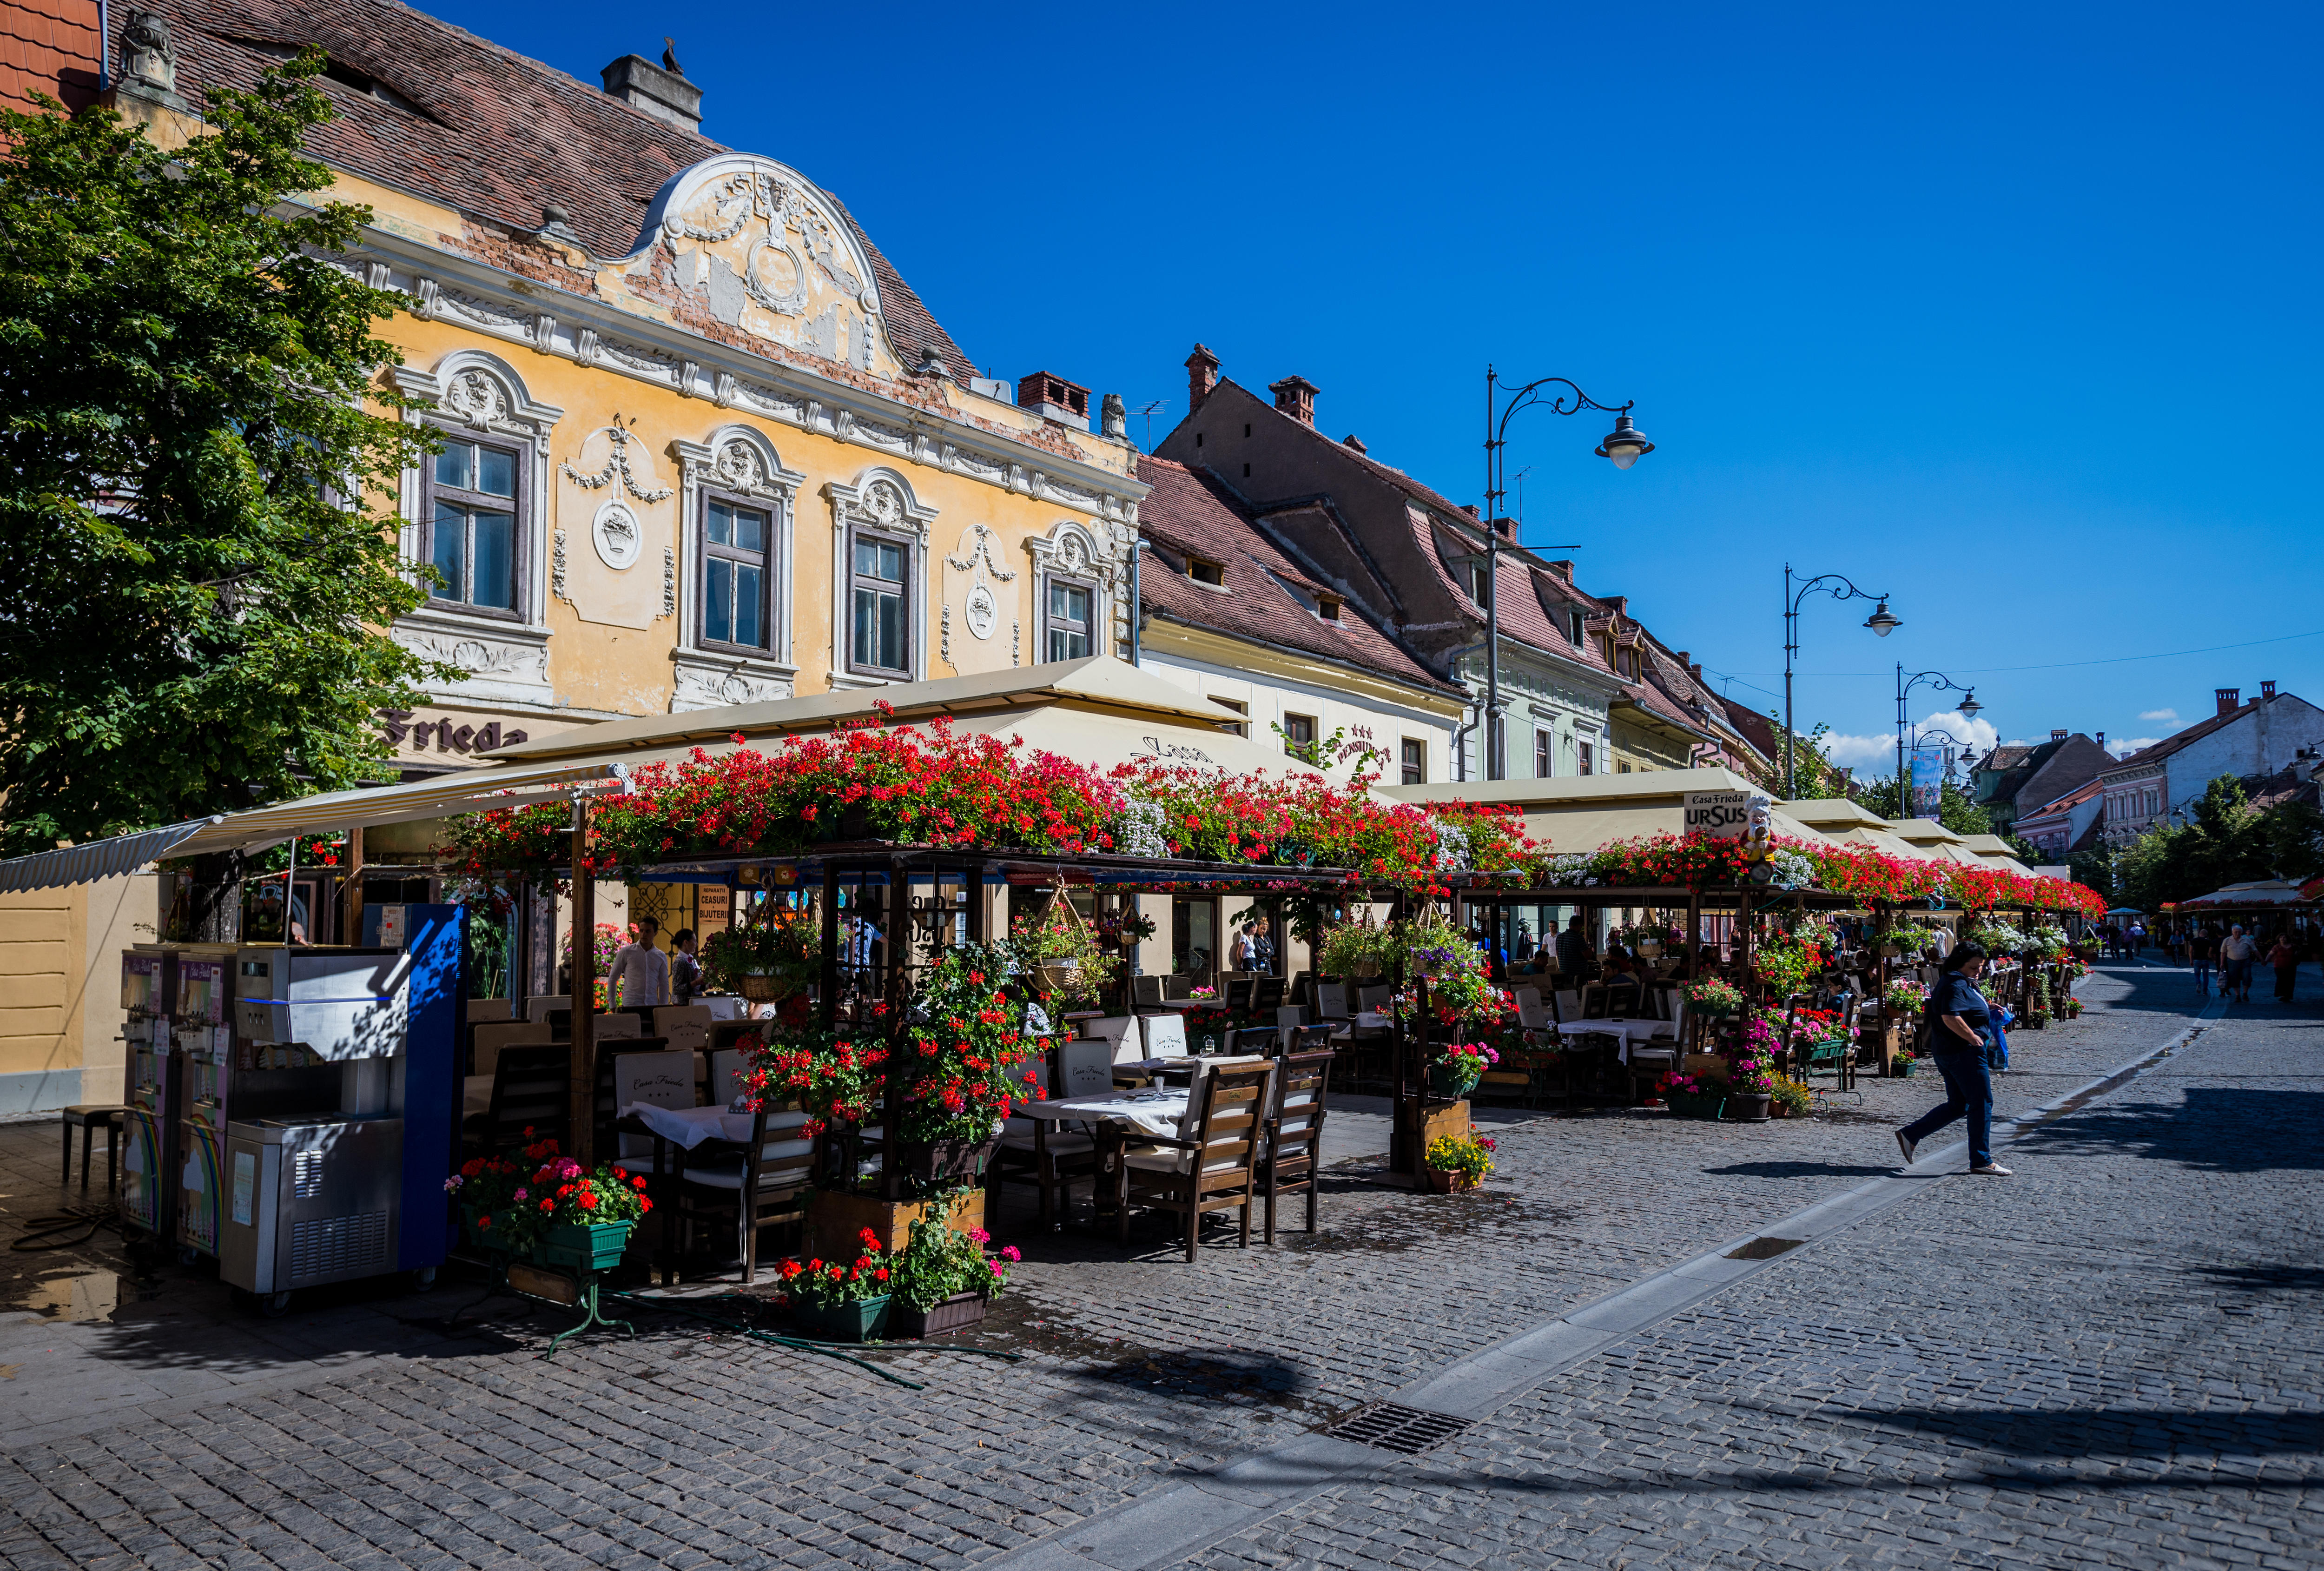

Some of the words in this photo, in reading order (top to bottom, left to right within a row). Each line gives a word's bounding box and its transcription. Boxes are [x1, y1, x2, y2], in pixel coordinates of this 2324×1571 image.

[375, 709, 528, 753] Frieda
[1143, 736, 1213, 763] Casa
[1337, 740, 1384, 771] PENSIUNEA
[1692, 795, 1712, 804] Casa
[1713, 794, 1743, 804] Frieda
[1686, 805, 1748, 828] URSUS
[1112, 1034, 1129, 1043] Frieda
[1166, 1036, 1181, 1044] Frieda
[1072, 1067, 1085, 1076] Casa
[1086, 1065, 1105, 1076] Frieda
[634, 1079, 653, 1090] Casa
[655, 1075, 684, 1087] Frieda
